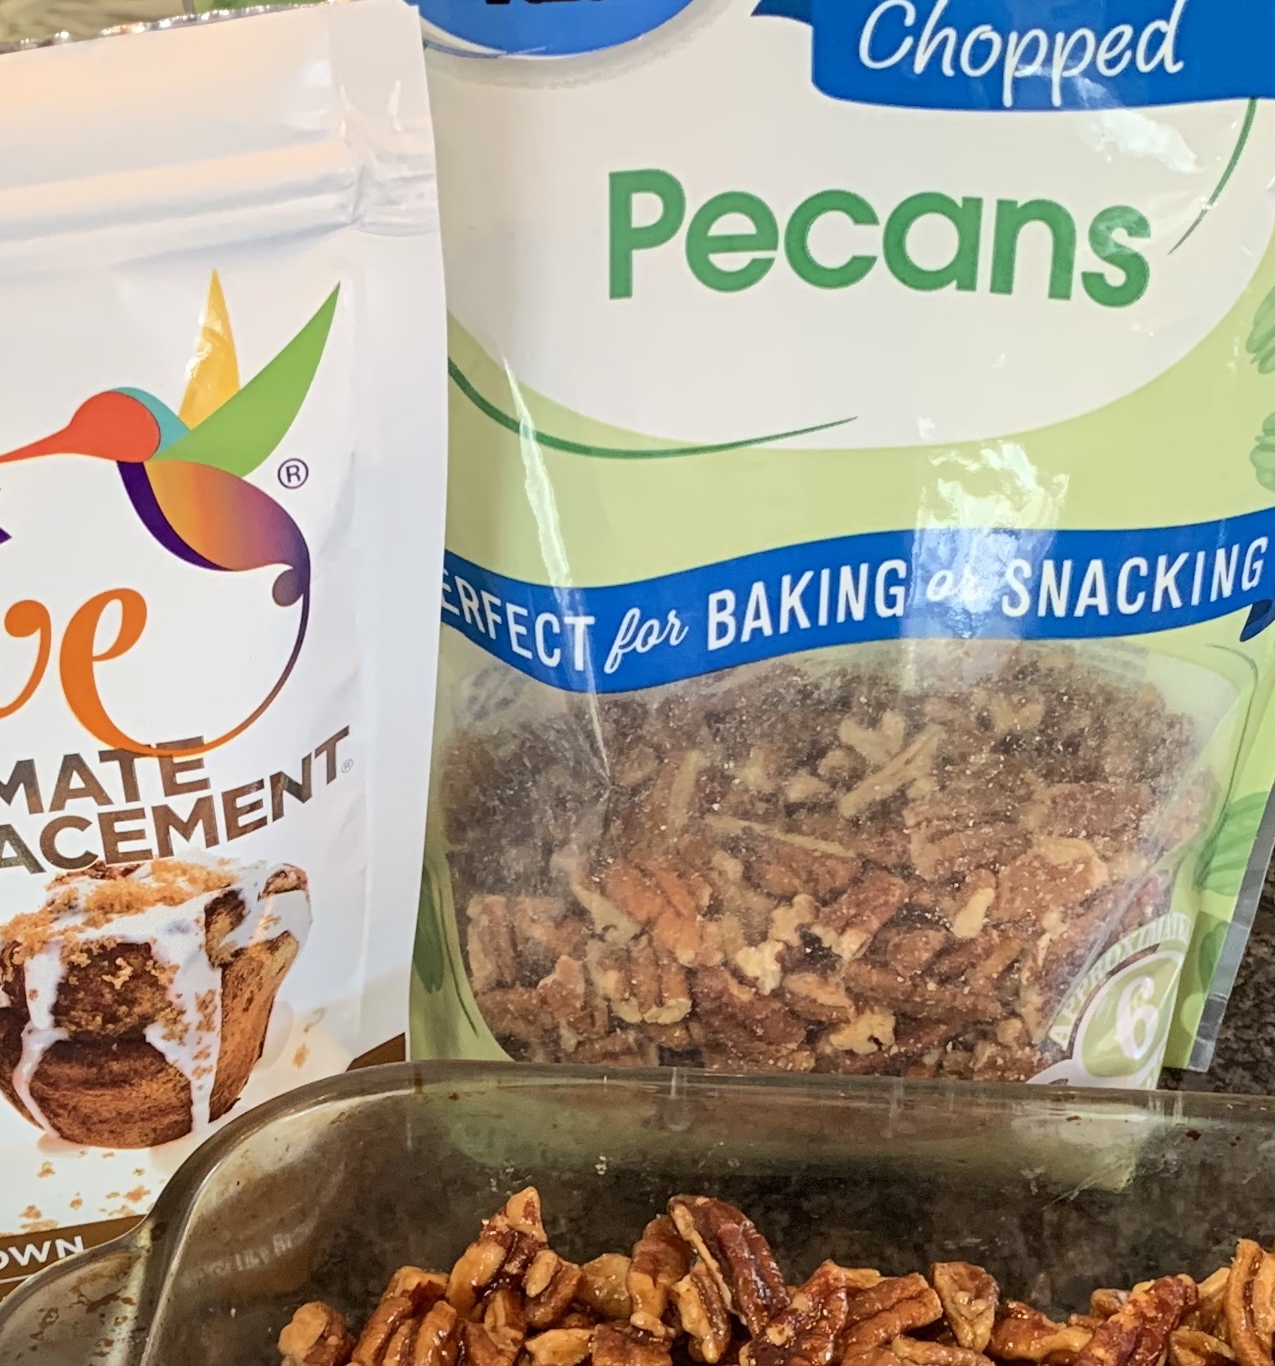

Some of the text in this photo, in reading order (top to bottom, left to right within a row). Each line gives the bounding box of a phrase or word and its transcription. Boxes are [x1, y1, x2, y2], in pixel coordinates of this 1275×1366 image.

[857, 0, 1185, 110] Chopped
[606, 168, 1152, 308] Pecans
[441, 567, 595, 671] ERFECT
[603, 607, 689, 673] for
[707, 558, 908, 651] BAKING
[1001, 536, 1270, 618] SNACKING
[1116, 976, 1159, 1060] 6
